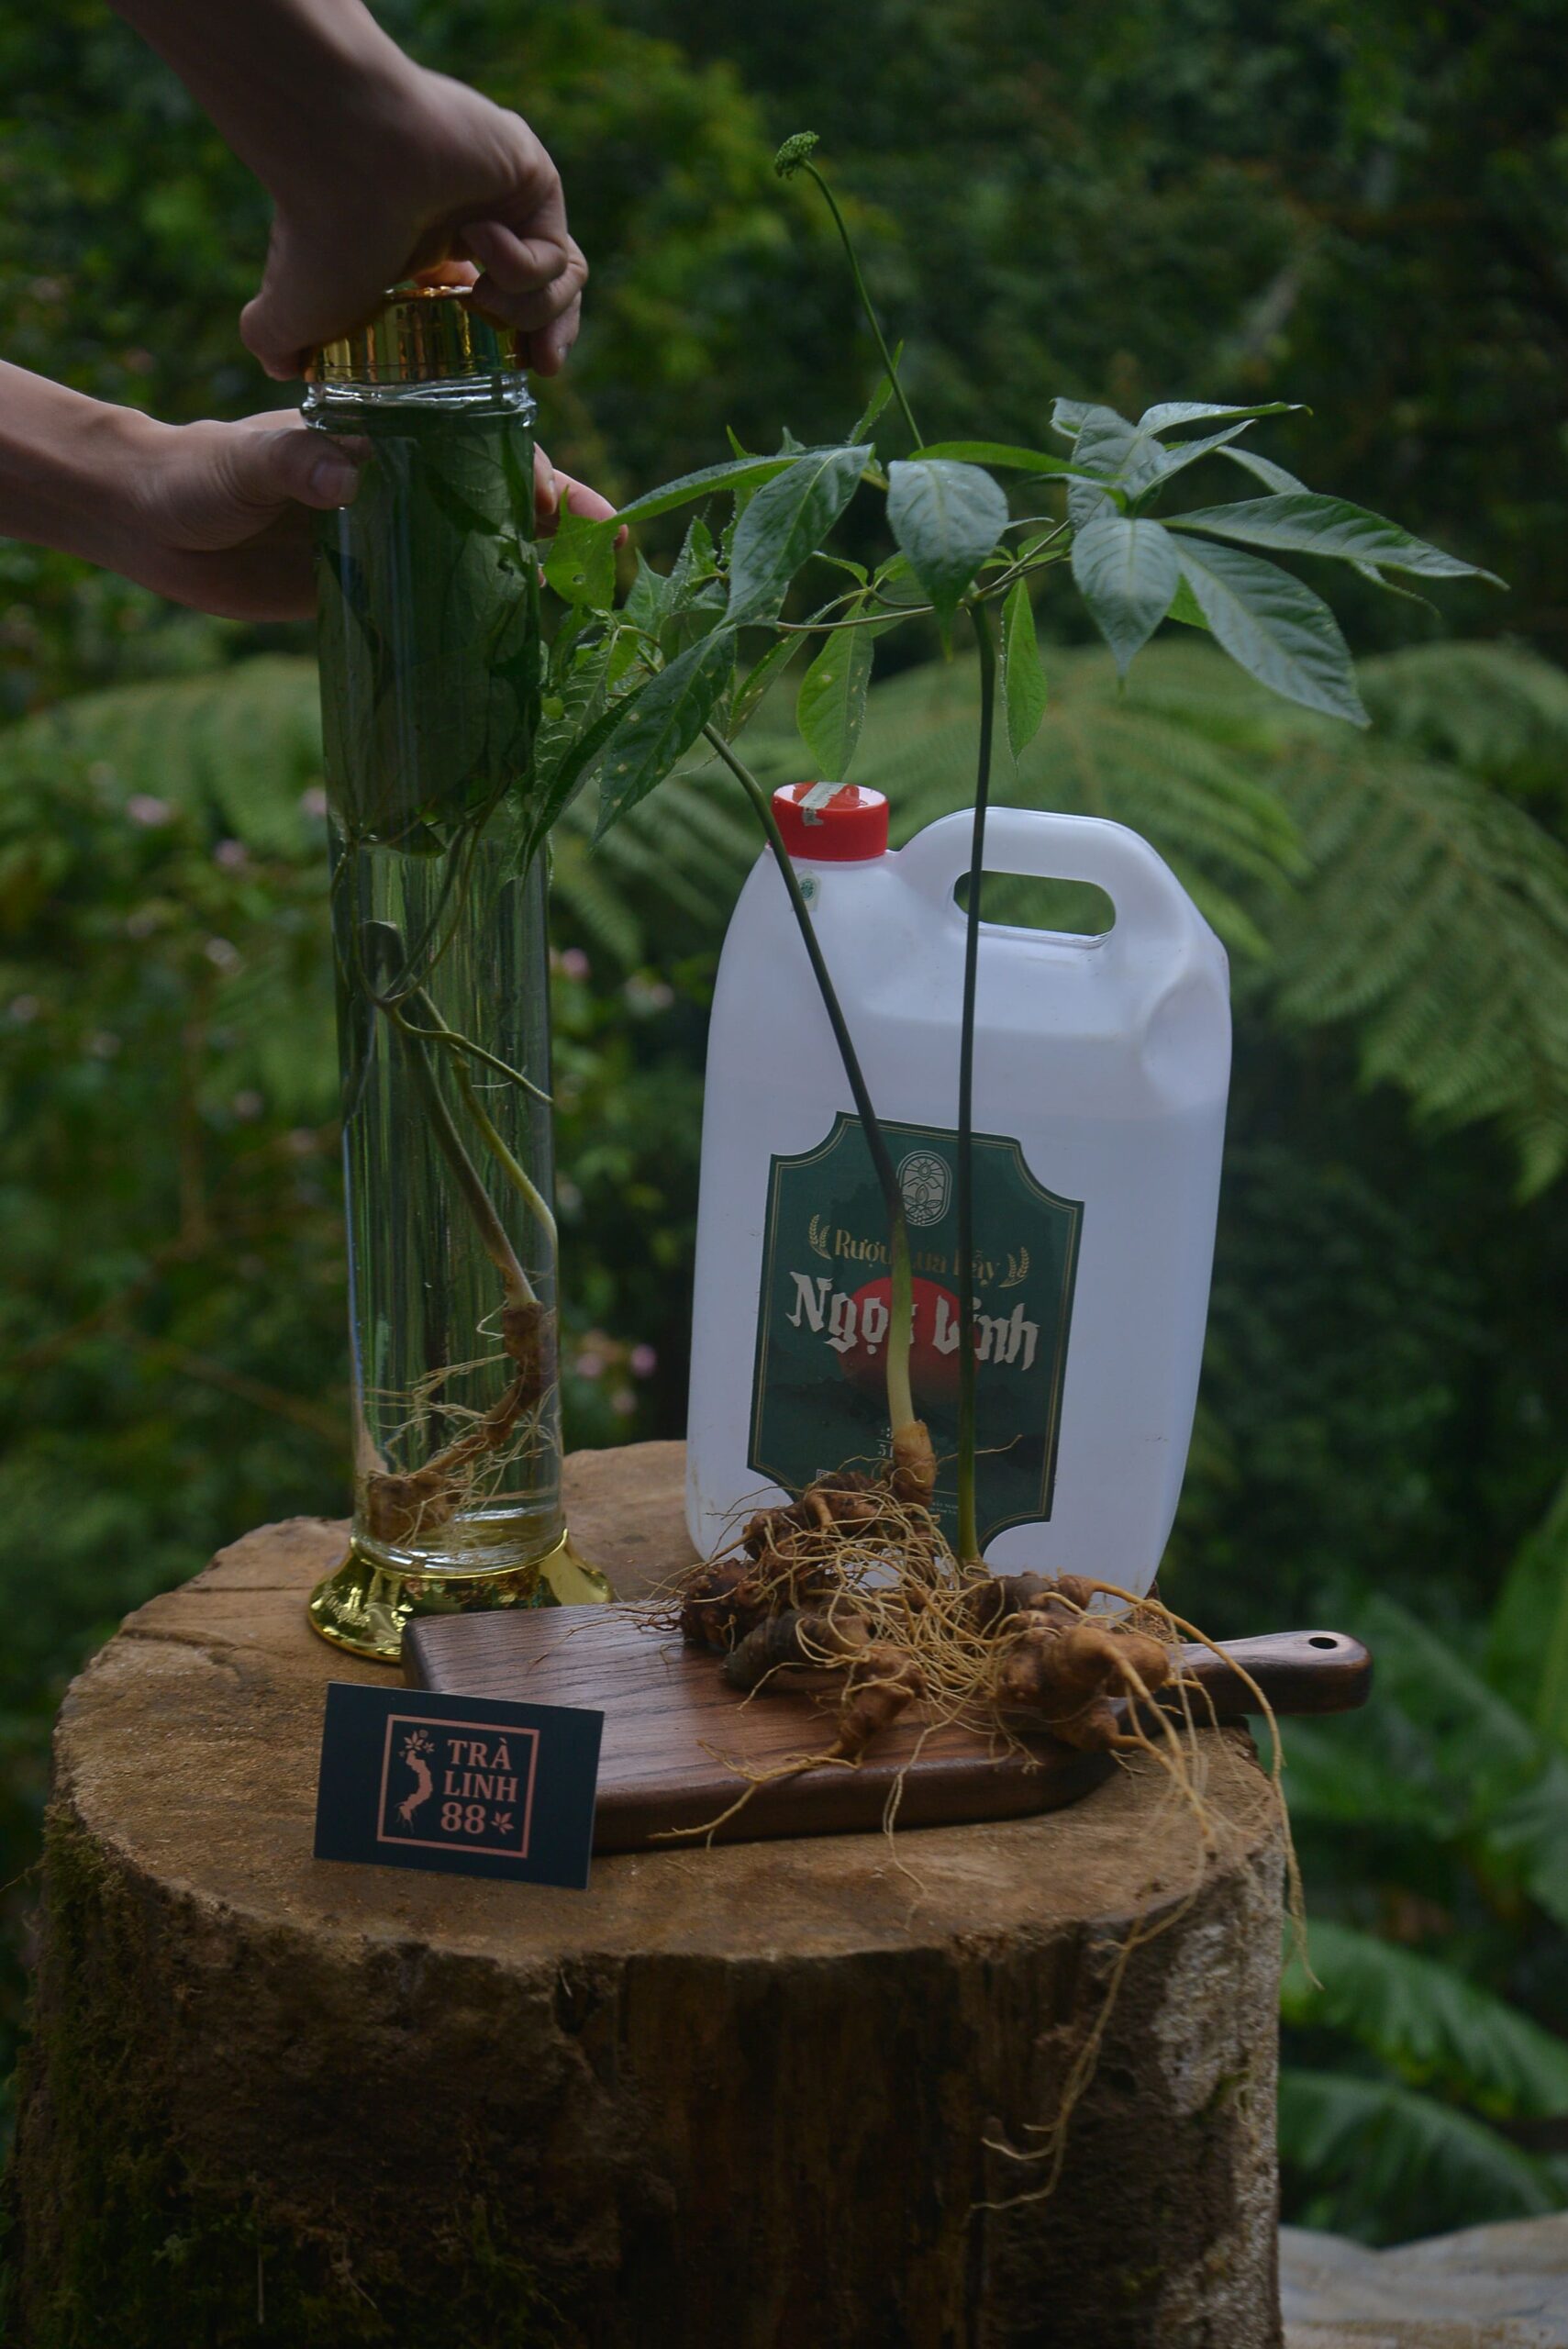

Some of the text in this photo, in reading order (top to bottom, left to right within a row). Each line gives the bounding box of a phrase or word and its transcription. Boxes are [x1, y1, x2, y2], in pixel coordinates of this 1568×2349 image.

[785, 1271, 918, 1355] Ngọ
[447, 1736, 512, 1770] TRÀ
[443, 1771, 518, 1802] LINH
[440, 1803, 486, 1834] 88
